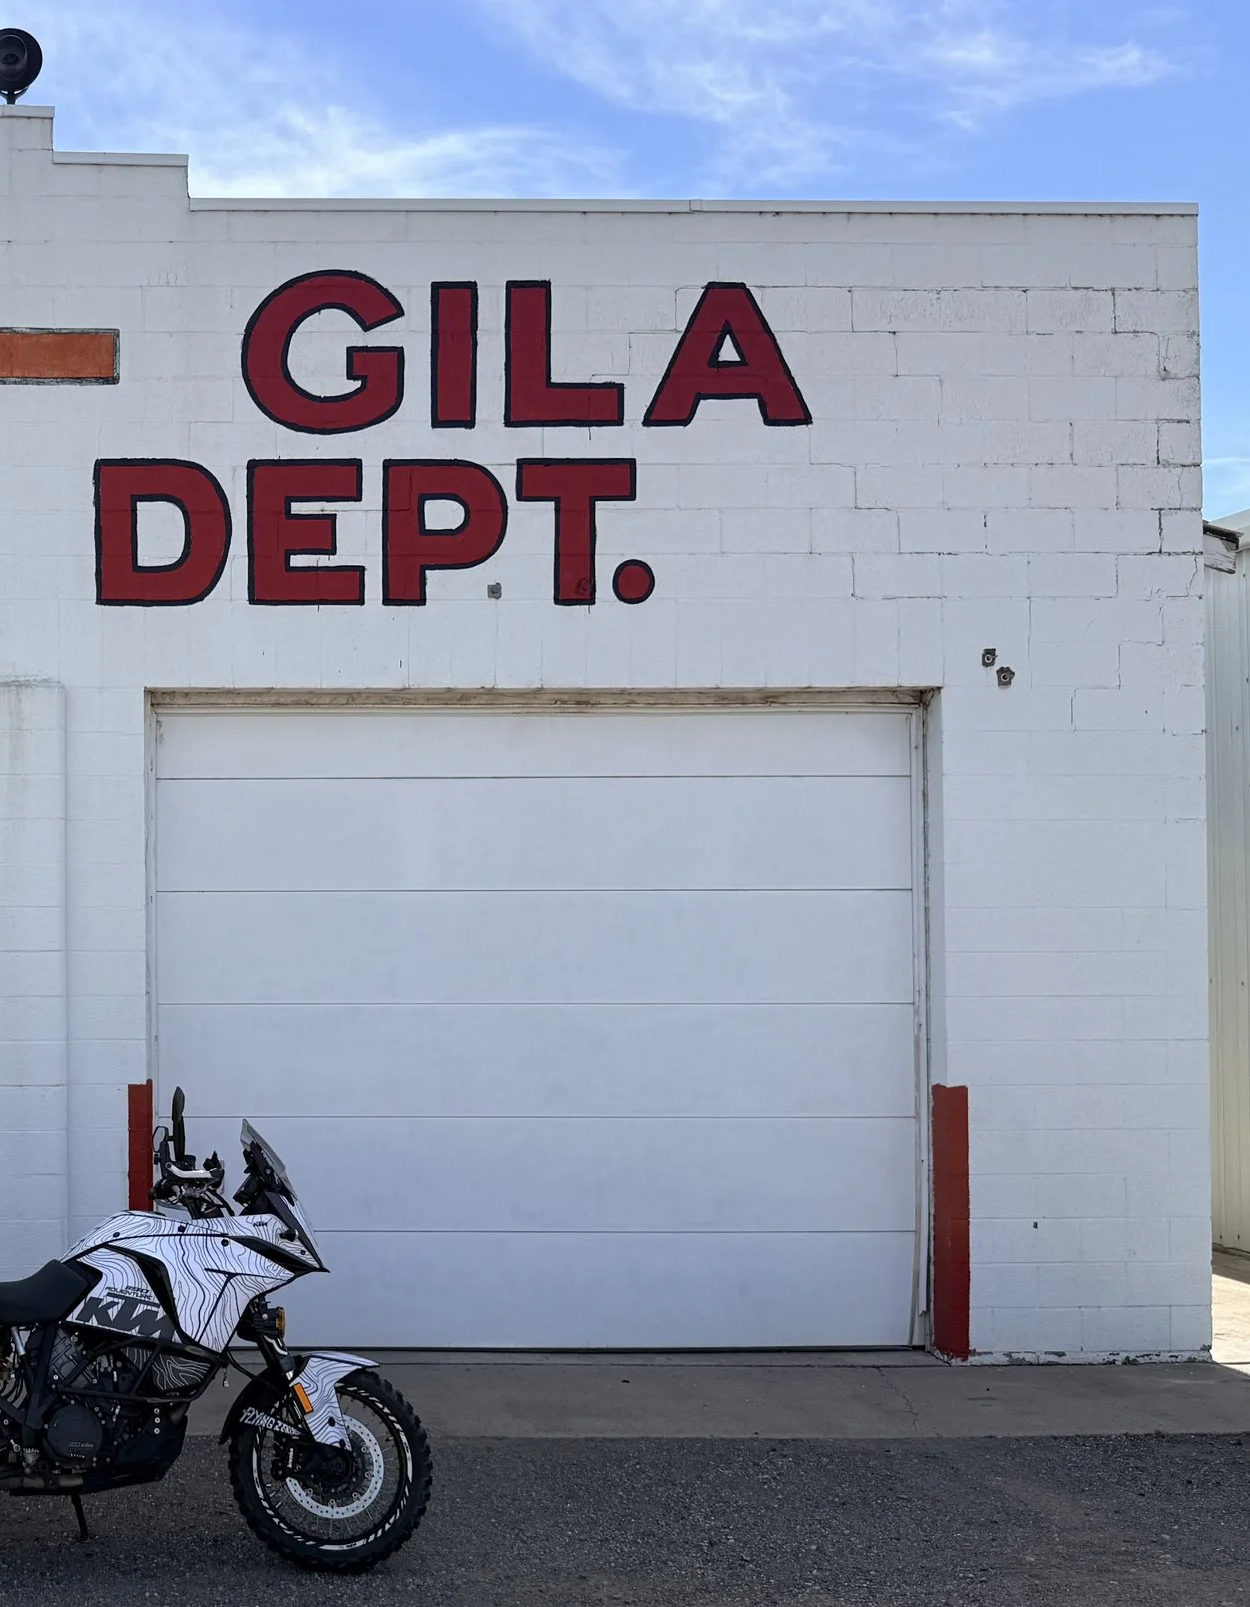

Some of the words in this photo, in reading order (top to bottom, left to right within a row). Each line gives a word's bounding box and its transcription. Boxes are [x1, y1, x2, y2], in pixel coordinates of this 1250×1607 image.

[241, 269, 812, 434] GILA
[93, 457, 655, 606] DEPT.
[74, 1292, 177, 1344] KTM
[239, 1406, 276, 1430] FLYING
